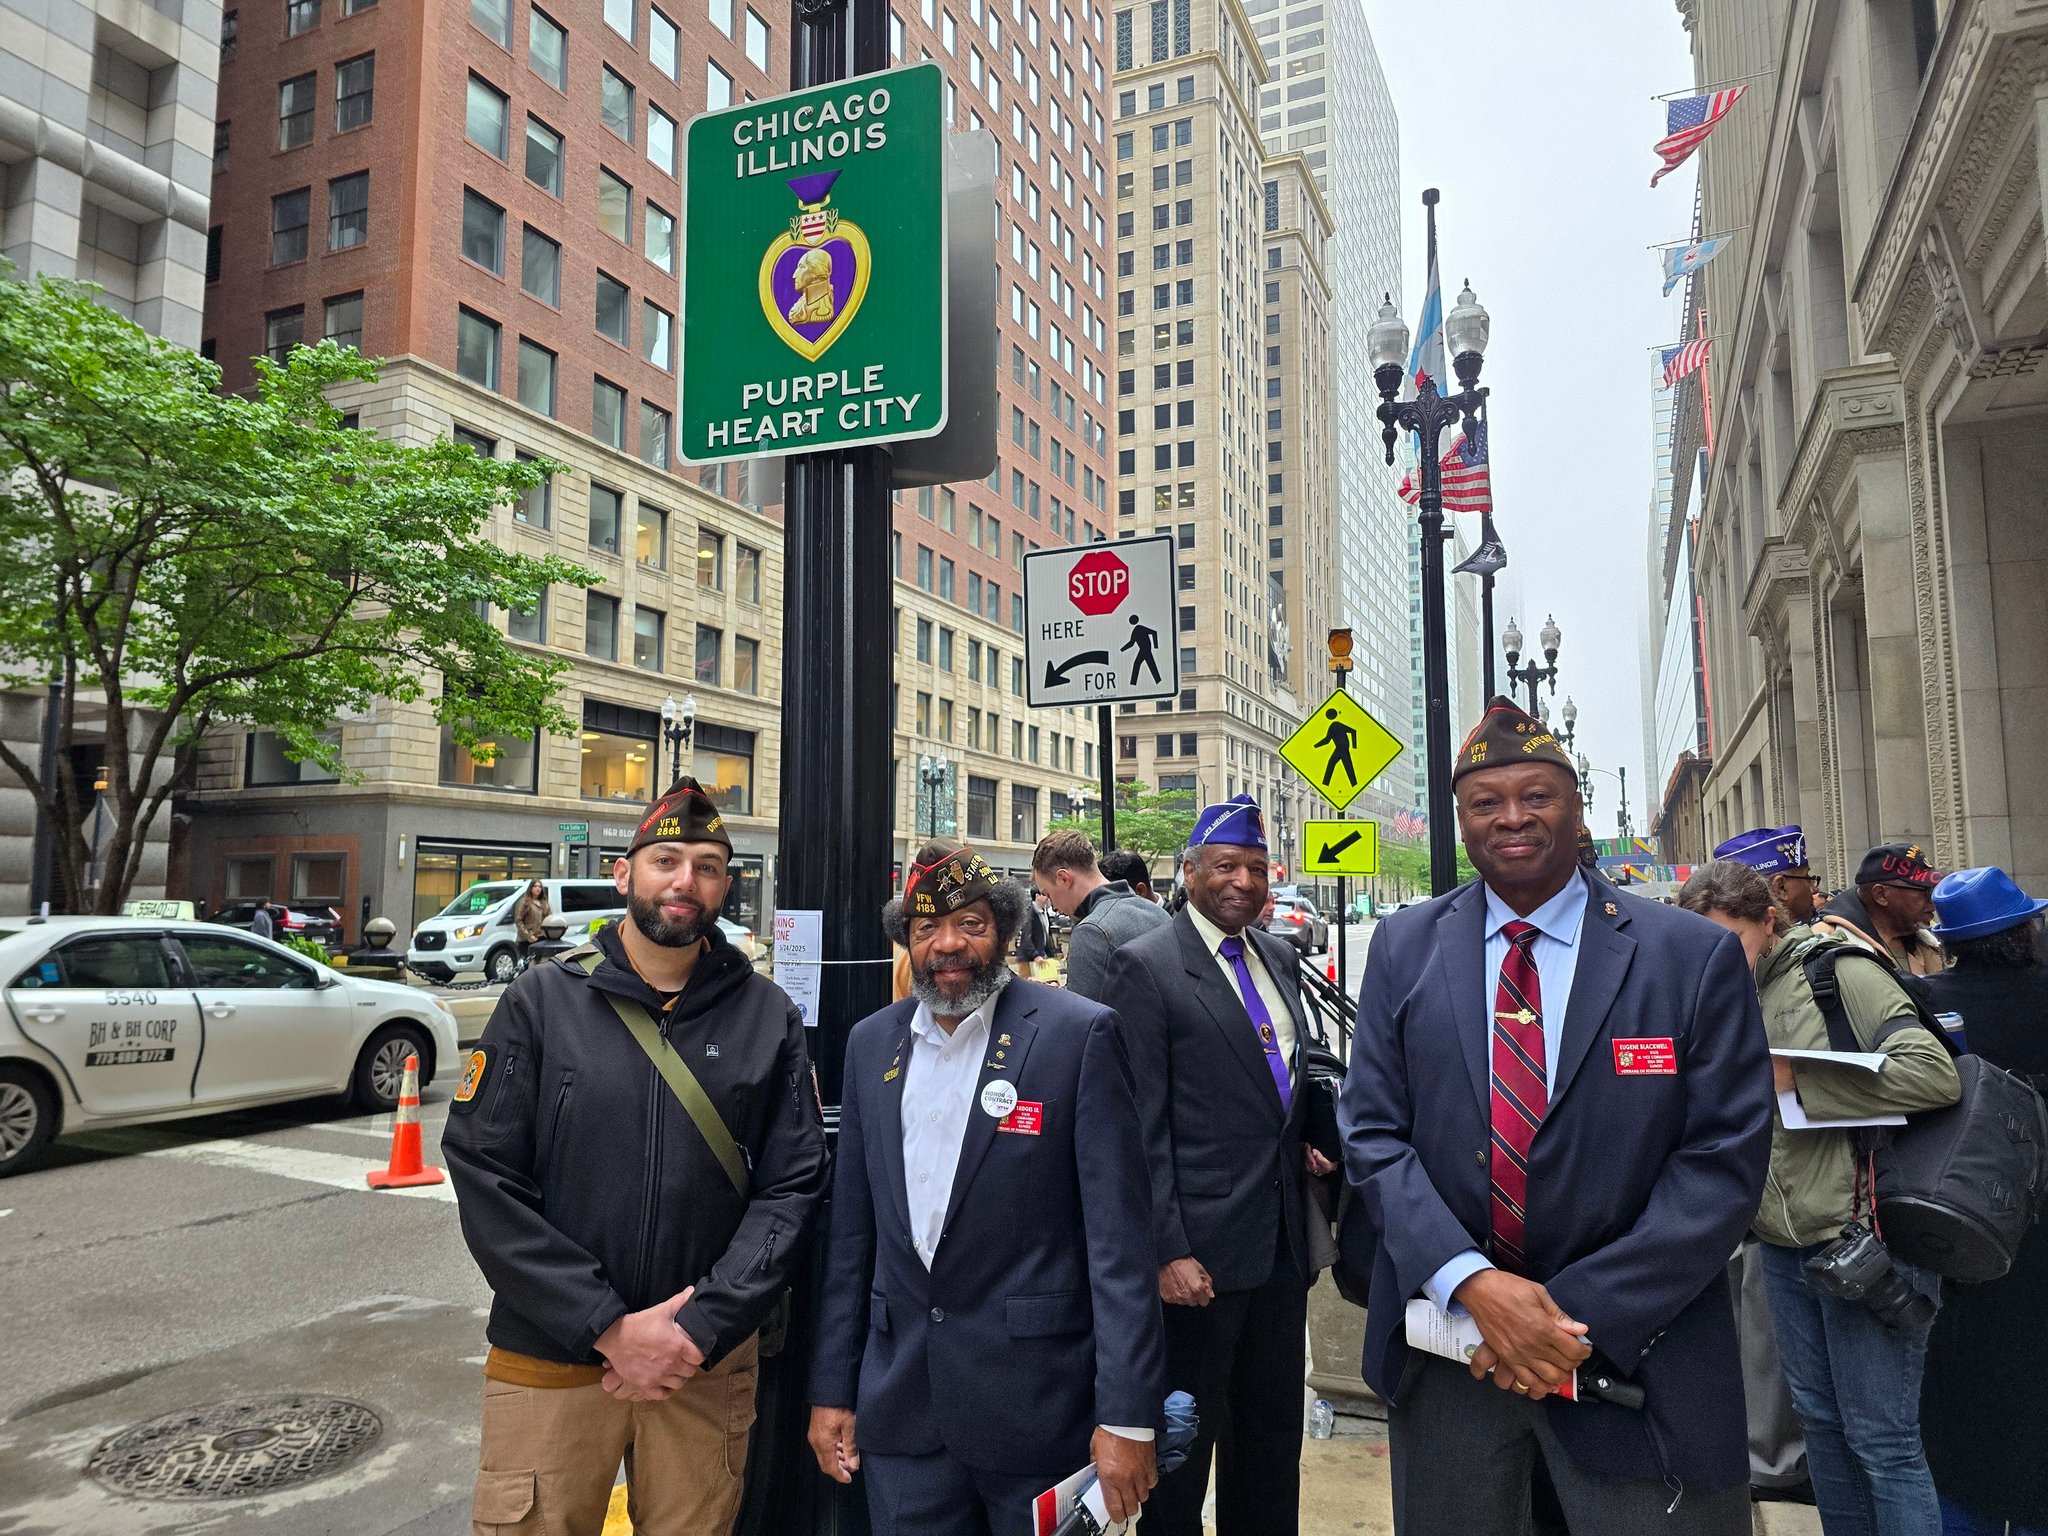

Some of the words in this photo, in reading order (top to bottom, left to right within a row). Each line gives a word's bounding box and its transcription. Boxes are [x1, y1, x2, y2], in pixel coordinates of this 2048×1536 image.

[733, 88, 891, 147] CHICAGO
[736, 122, 887, 178] ILLINOIS
[742, 364, 884, 410] PURPLE
[707, 407, 824, 448] HEART
[839, 393, 922, 431] CITY
[1071, 569, 1127, 598] STOP
[1042, 620, 1084, 641] HERE
[1084, 672, 1116, 691] FOR
[1470, 741, 1488, 755] VFW
[1472, 752, 1487, 763] 911
[660, 817, 679, 827] VFW
[602, 827, 618, 837] H&R
[657, 826, 681, 836] 2868
[1882, 854, 1944, 885] USMC
[916, 892, 932, 904] VFW
[916, 903, 936, 914] 4183
[776, 917, 795, 929] KING
[776, 930, 790, 941] ONE
[105, 989, 157, 1006] 5540
[89, 1022, 107, 1048] BH
[111, 1021, 122, 1039] &
[126, 1021, 141, 1038] BH
[146, 1019, 177, 1043] CORP
[984, 1096, 1014, 1105] CONTRACT
